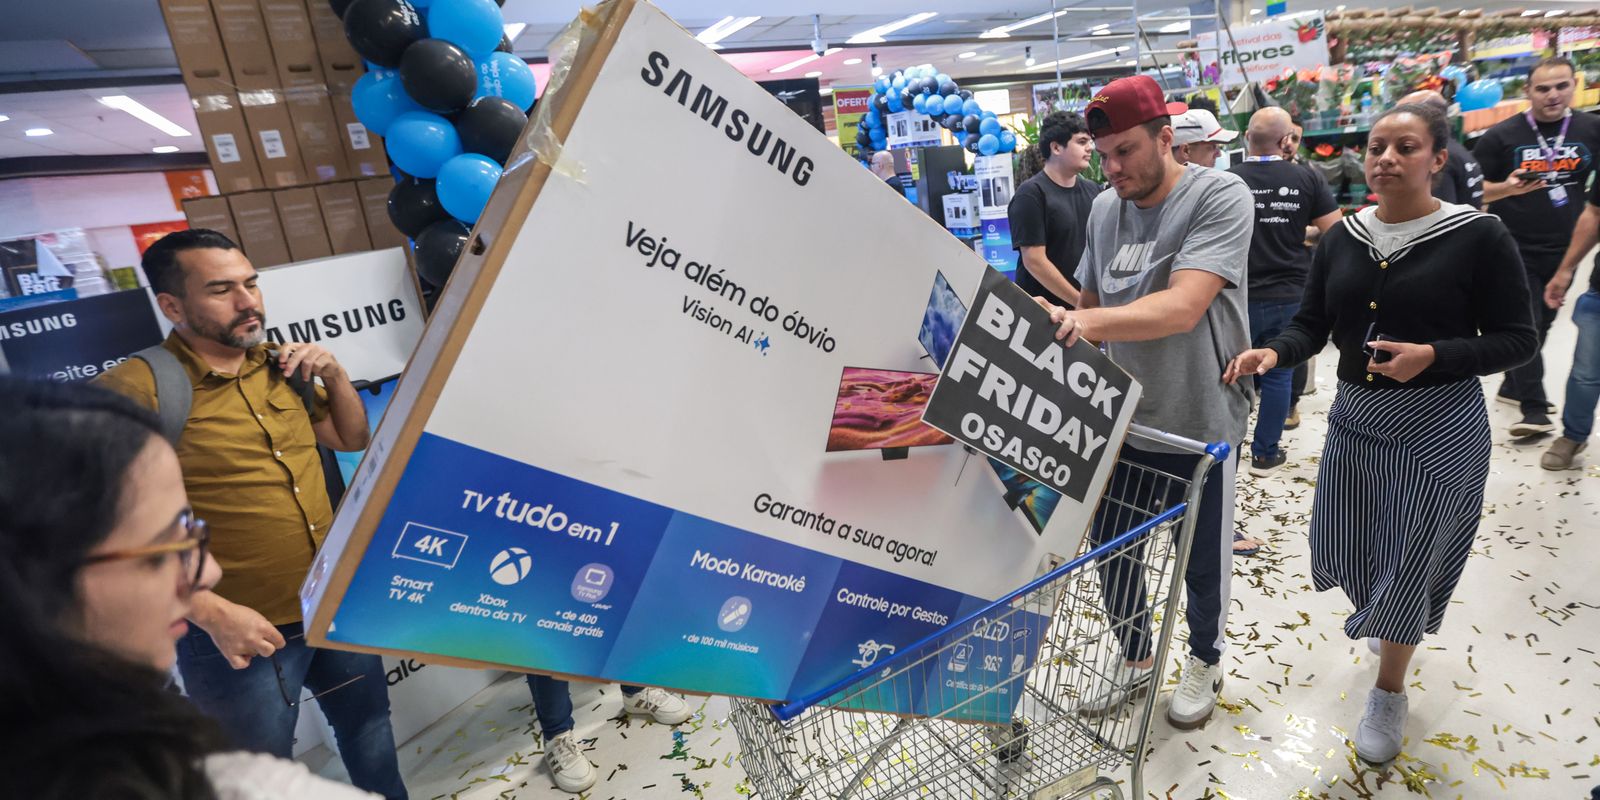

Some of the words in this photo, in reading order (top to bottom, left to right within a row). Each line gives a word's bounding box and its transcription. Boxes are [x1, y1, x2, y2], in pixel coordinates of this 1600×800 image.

[1221, 45, 1295, 65] flores
[837, 97, 869, 107] OFERT
[640, 50, 815, 187] SAMSUNG
[1520, 158, 1582, 172] FRIAY
[1522, 147, 1579, 161] BLCK
[625, 220, 682, 271] Veja
[684, 261, 746, 306] além
[749, 296, 779, 322] do
[782, 311, 836, 353] óbvio
[0, 313, 77, 340] MSUNG
[266, 299, 406, 346] AMSUNG
[682, 295, 733, 335] Vision
[734, 325, 754, 345] AI
[976, 291, 1122, 419] BLACK
[947, 342, 1108, 462] FRIDAY
[960, 412, 1071, 487] OSASCO
[462, 489, 493, 513] TV
[495, 492, 568, 532] tudo
[568, 521, 602, 543] em
[604, 521, 620, 546] 1
[754, 493, 836, 535] Garanta
[837, 523, 852, 540] a
[852, 528, 885, 550] sua
[885, 539, 938, 567] agora!
[414, 535, 448, 556] 4K
[690, 550, 740, 576] Modo
[741, 563, 805, 592] Karaokê
[391, 575, 434, 592] Smart
[389, 588, 407, 600] TV
[407, 592, 425, 604] 4K
[477, 593, 509, 608] Xbox
[836, 587, 889, 612] Controle
[888, 603, 912, 618] por
[911, 606, 949, 626] Gestos
[449, 602, 491, 618] dentro
[492, 610, 510, 621] da
[511, 612, 527, 624] TV
[562, 610, 577, 621] de
[578, 612, 598, 625] 400
[536, 618, 574, 633] canais
[572, 626, 604, 638] grátis
[687, 634, 700, 644] de
[701, 635, 714, 646] 100
[714, 638, 727, 649] mil
[727, 641, 759, 654] músicas
